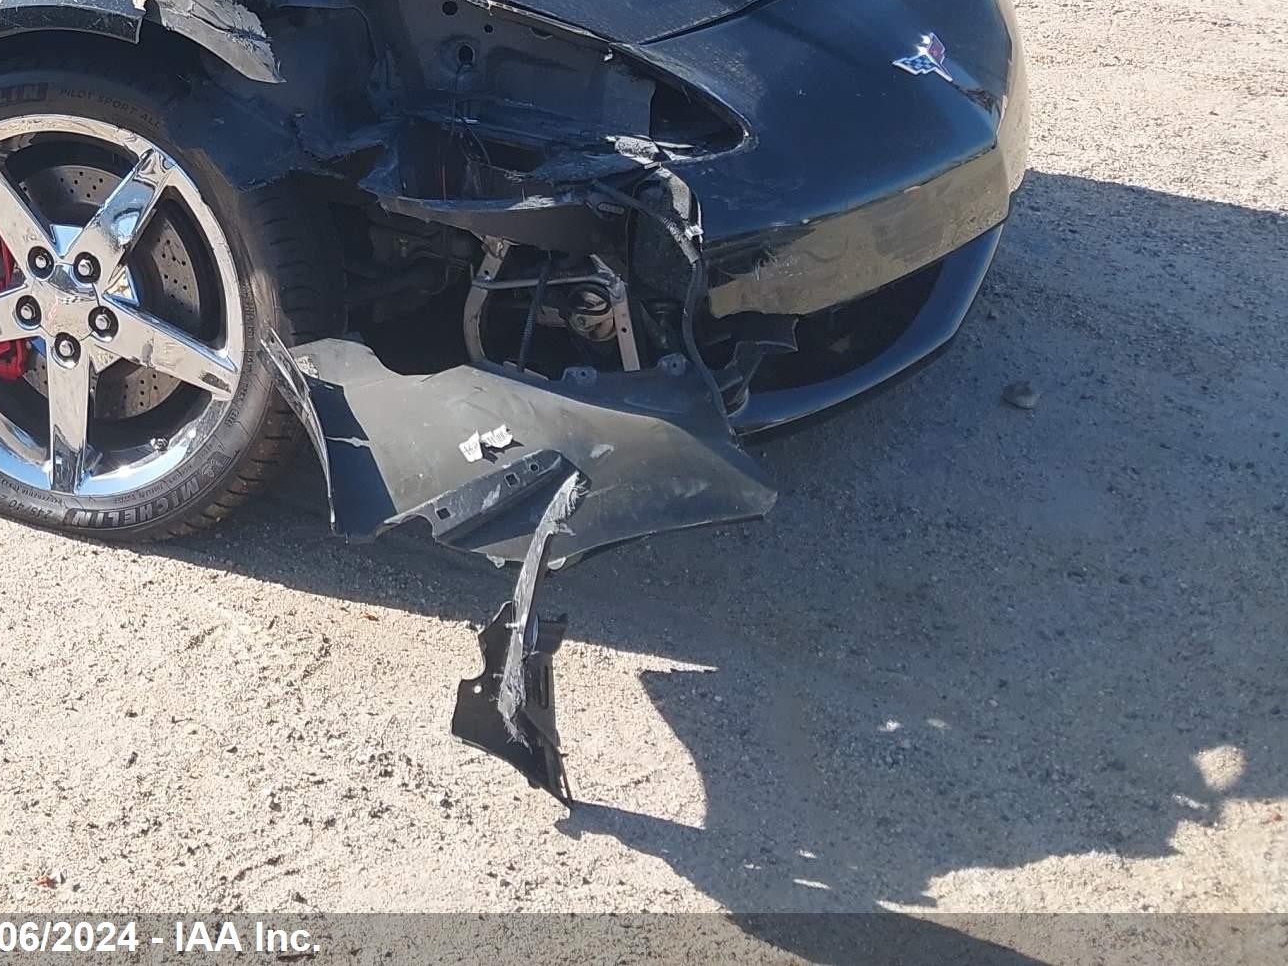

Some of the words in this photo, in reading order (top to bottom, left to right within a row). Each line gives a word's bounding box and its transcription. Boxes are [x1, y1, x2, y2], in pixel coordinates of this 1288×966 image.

[60, 88, 96, 99] PILOT
[98, 97, 137, 114] SPORT
[73, 477, 200, 528] MICHELIN
